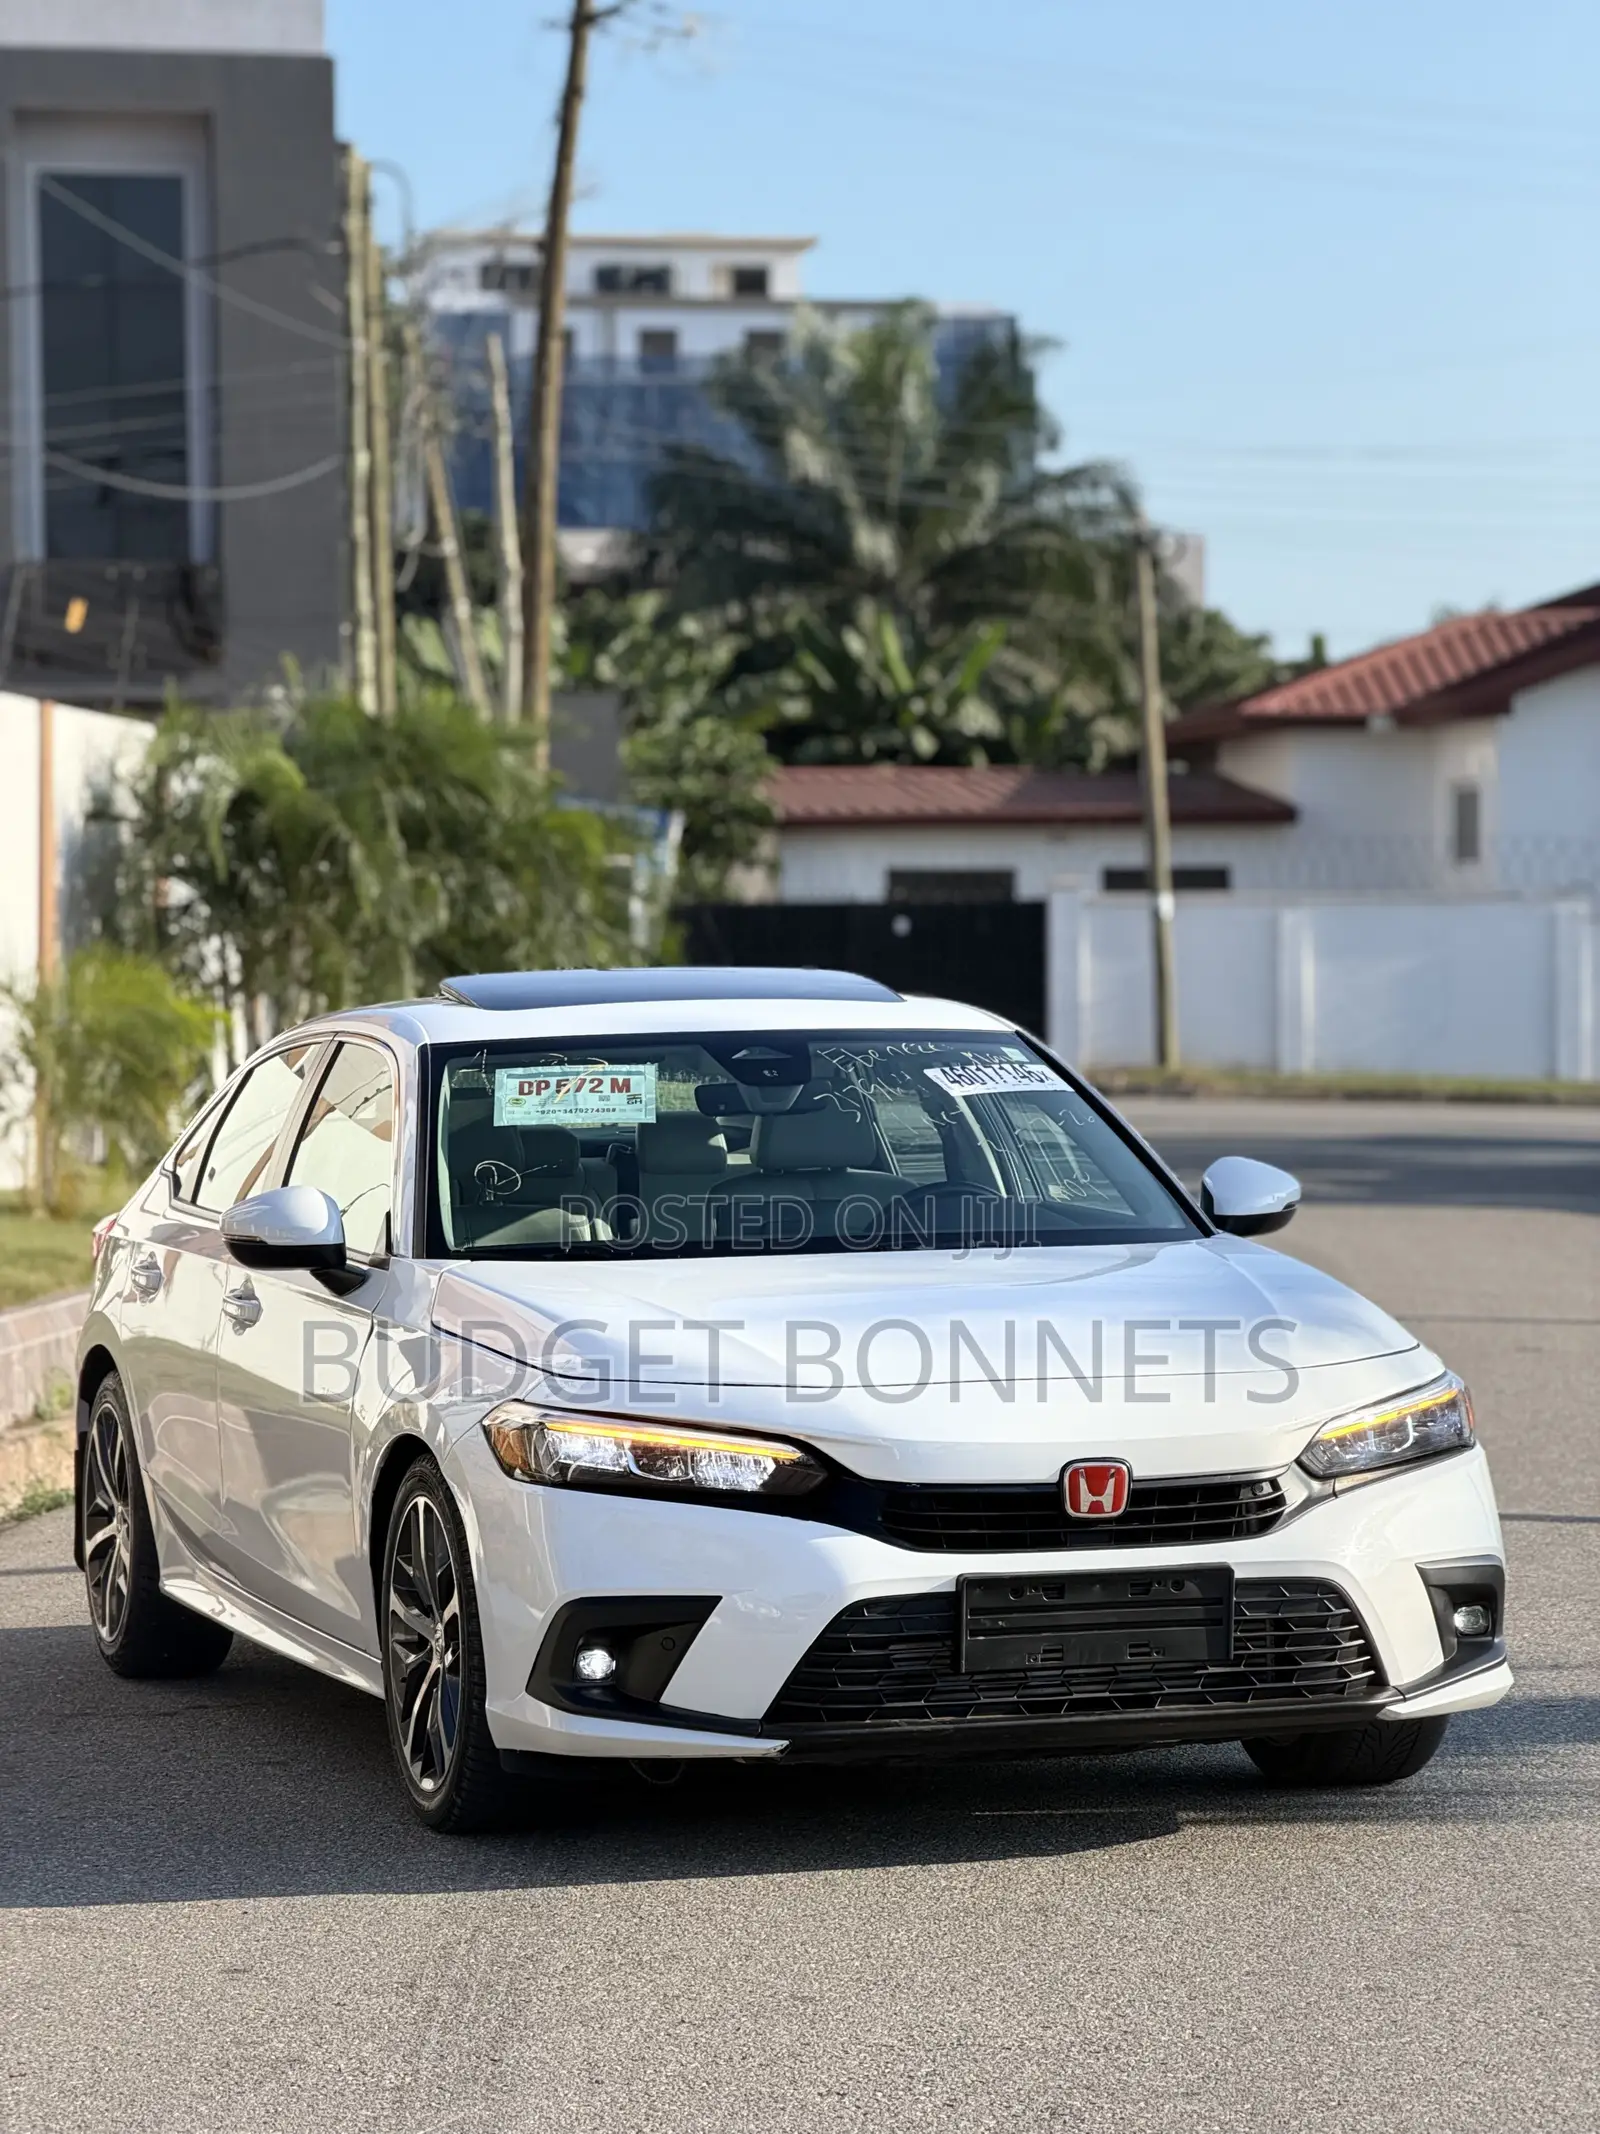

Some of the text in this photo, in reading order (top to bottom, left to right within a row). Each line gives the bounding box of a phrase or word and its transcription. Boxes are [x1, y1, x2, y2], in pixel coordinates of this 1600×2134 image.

[518, 1077, 631, 1096] DP 572 M
